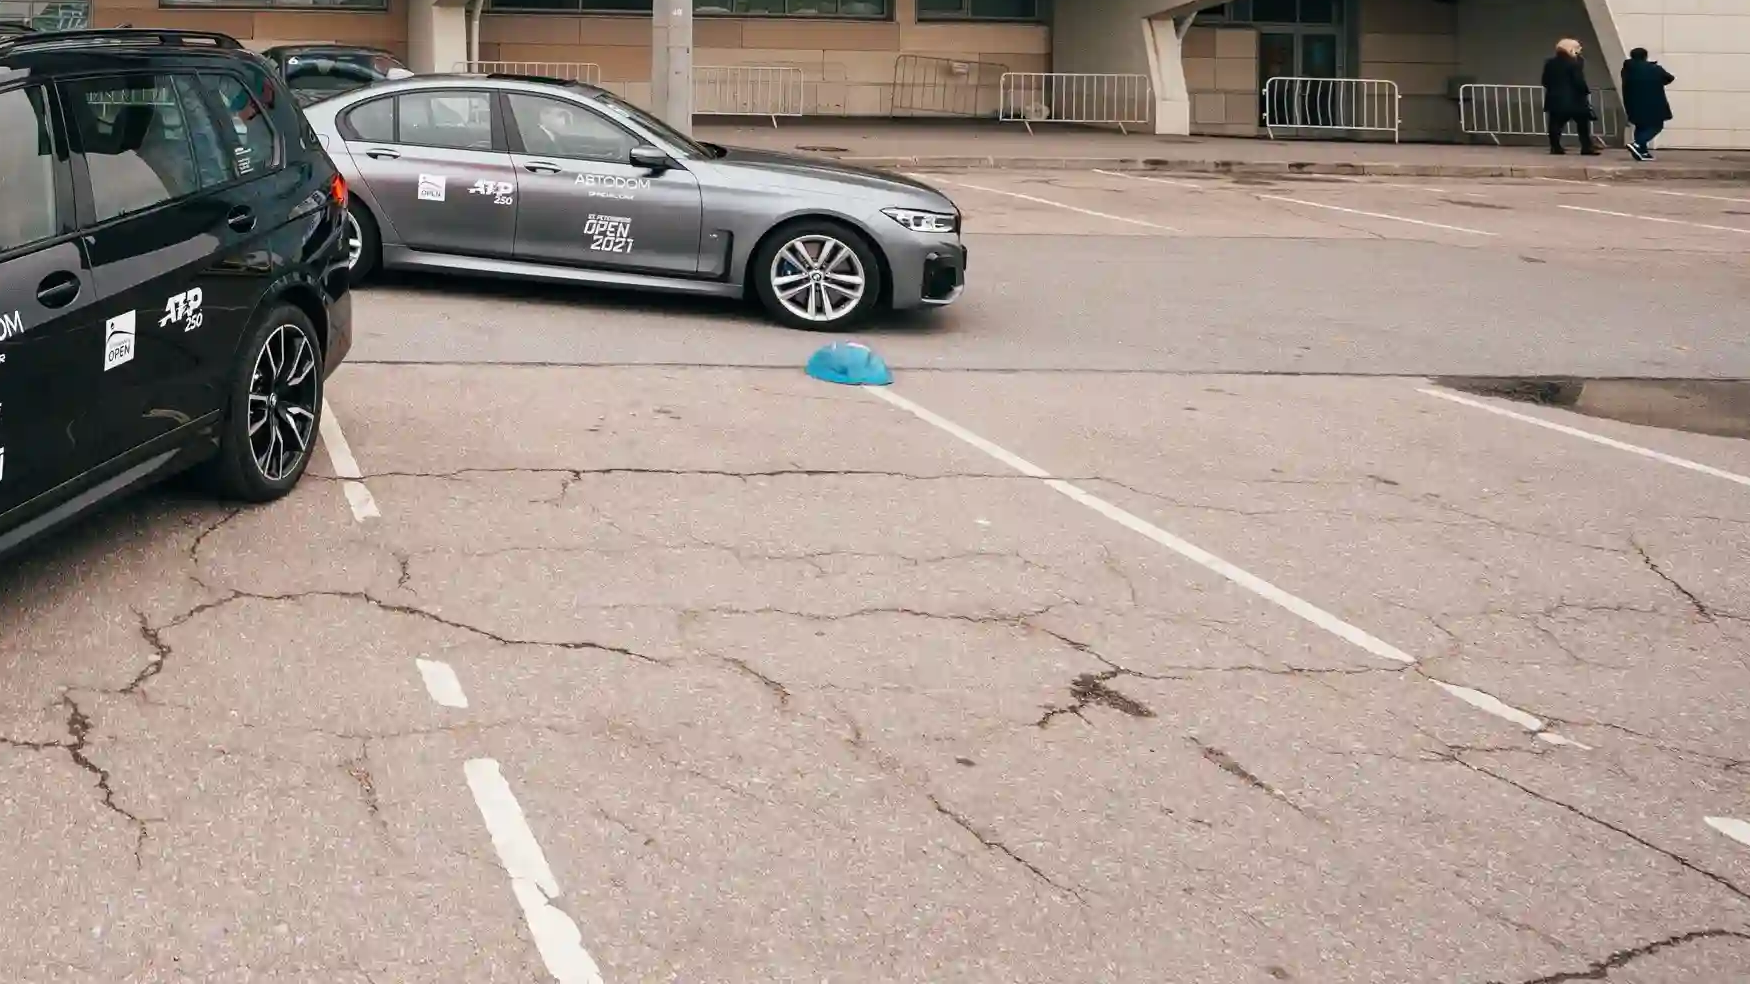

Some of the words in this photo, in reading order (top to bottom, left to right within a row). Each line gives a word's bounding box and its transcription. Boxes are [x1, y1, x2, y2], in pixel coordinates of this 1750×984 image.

[421, 189, 441, 198] OPEN
[467, 178, 514, 196] ATP
[493, 195, 514, 205] 250
[584, 219, 630, 238] OPEN
[590, 235, 634, 254] 2021
[158, 287, 203, 328] ATP
[185, 312, 203, 333] 250
[108, 344, 130, 362] OPEN
